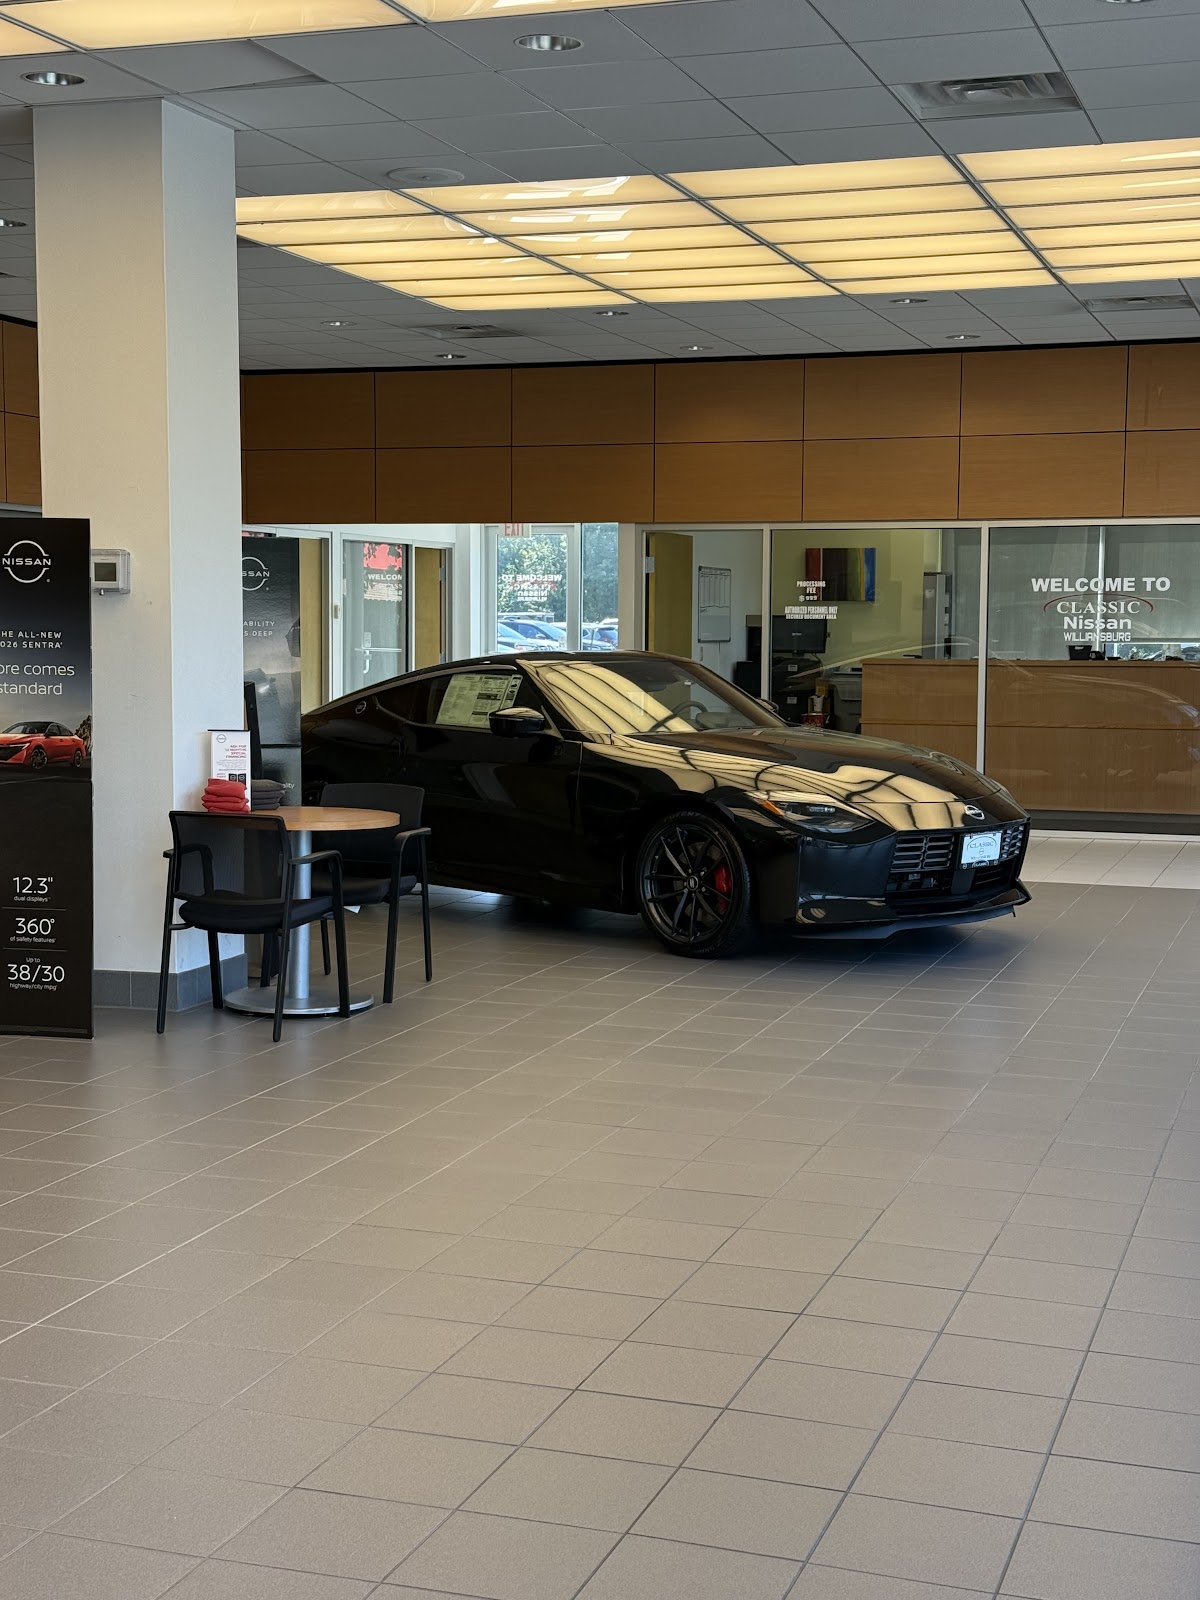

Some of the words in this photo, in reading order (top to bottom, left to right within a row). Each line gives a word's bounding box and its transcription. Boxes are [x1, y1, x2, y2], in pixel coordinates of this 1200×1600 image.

[2, 558, 52, 566] NISSAN
[1031, 578, 1136, 592] WELCOME
[1142, 577, 1170, 592] TO
[1056, 601, 1140, 614] CLASSIC
[1064, 616, 1132, 630] Nissan
[0, 664, 20, 675] ore
[24, 665, 74, 676] comes
[13, 877, 53, 894] 12.3"
[16, 918, 55, 935] 360°
[8, 964, 65, 982] 38/30
